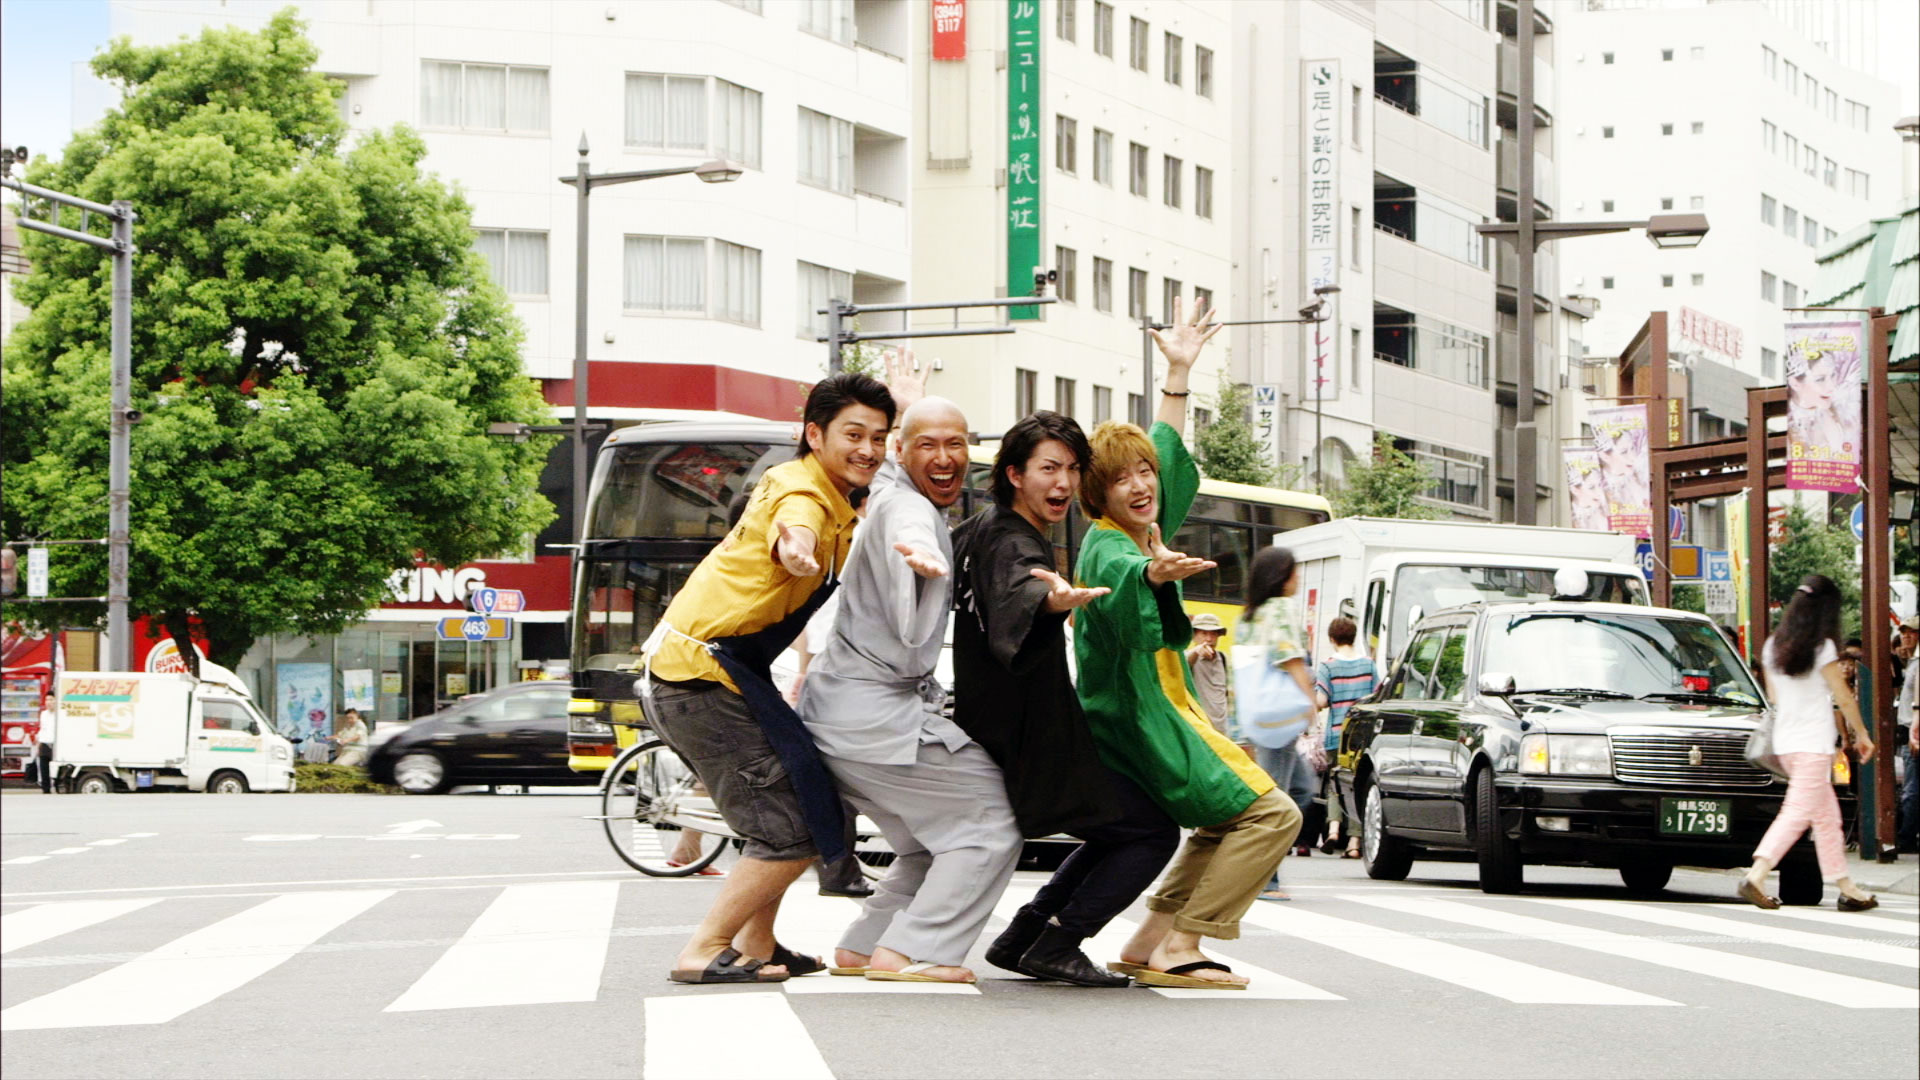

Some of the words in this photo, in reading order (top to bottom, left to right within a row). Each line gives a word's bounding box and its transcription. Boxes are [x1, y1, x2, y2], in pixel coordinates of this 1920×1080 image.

[937, 19, 960, 33] 5117
[1312, 91, 1332, 244] 足と靴の研究所
[1635, 552, 1654, 571] 46
[484, 591, 493, 607] 6
[464, 621, 486, 635] 463
[1698, 801, 1717, 811] 500
[1678, 812, 1727, 832] 17-99
